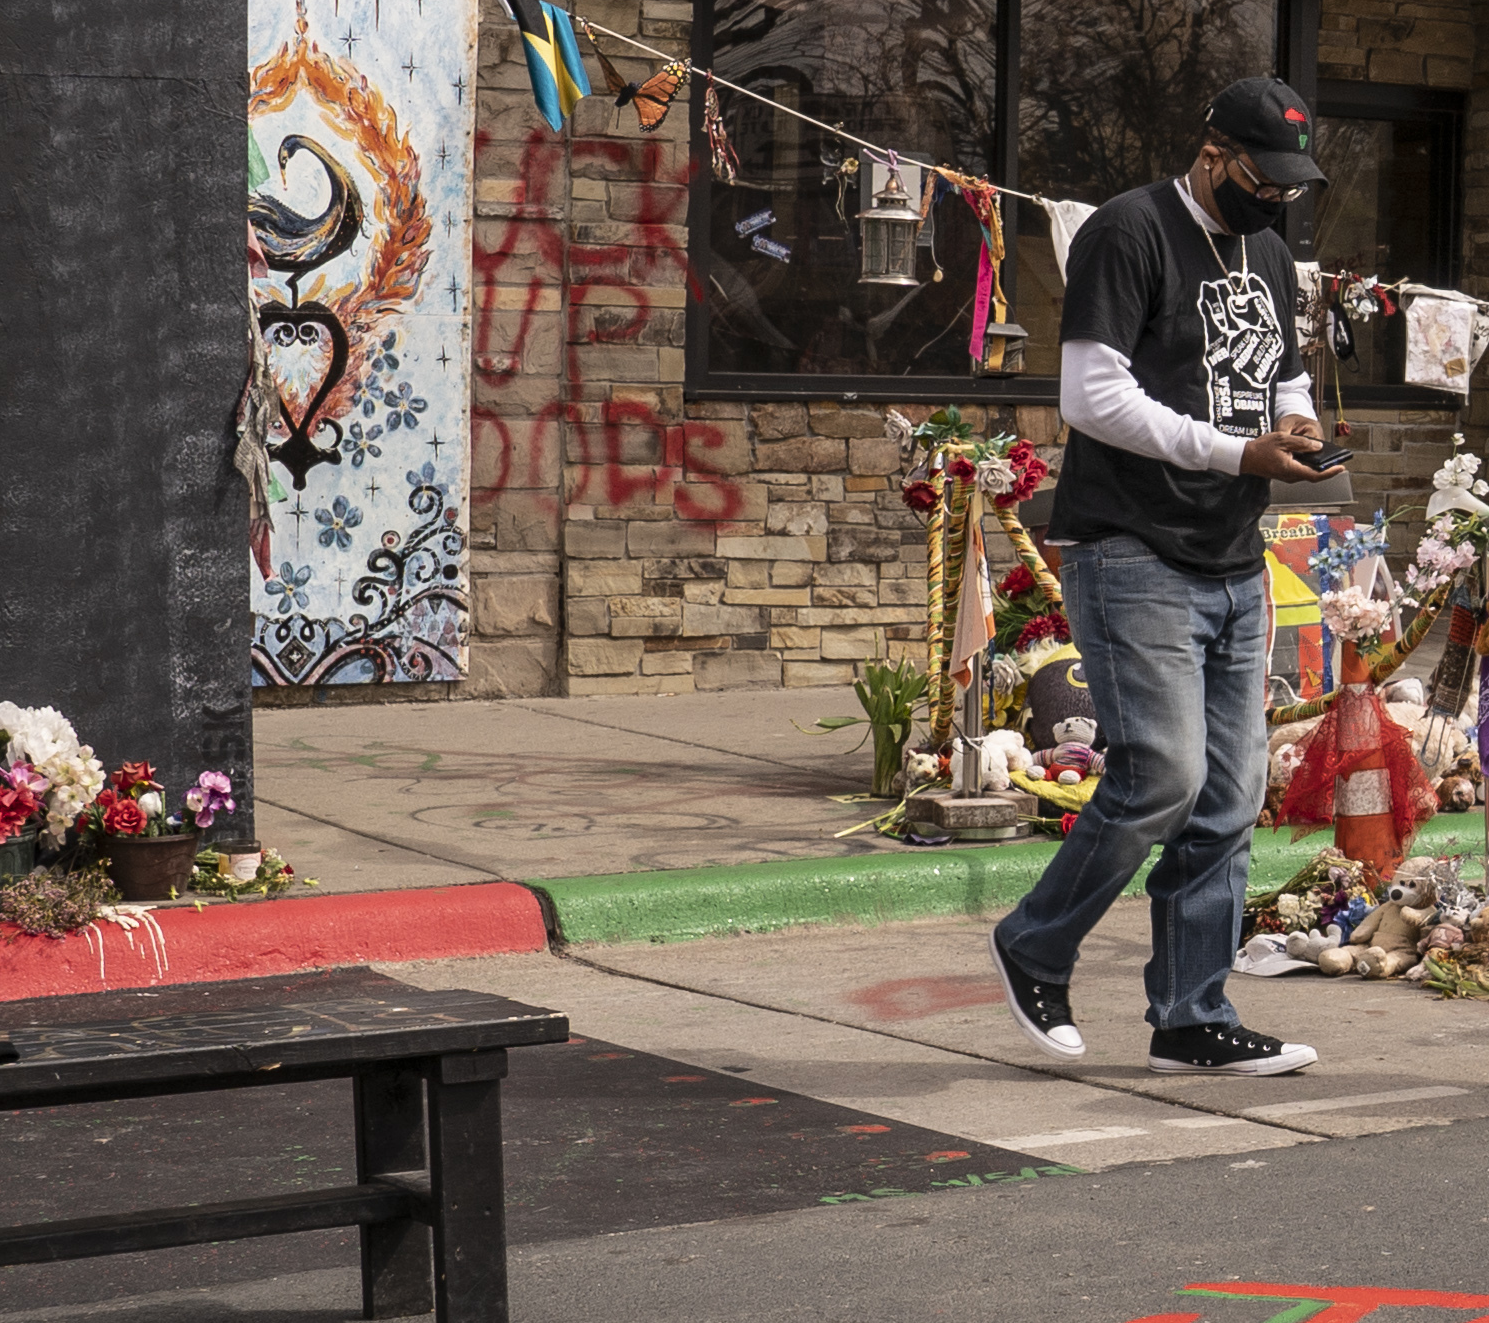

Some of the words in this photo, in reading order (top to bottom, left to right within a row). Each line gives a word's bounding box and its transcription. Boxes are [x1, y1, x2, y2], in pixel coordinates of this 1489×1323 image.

[1218, 376, 1233, 417] ROSA
[1234, 399, 1264, 411] OBAMA
[1219, 424, 1245, 435] DREAM
